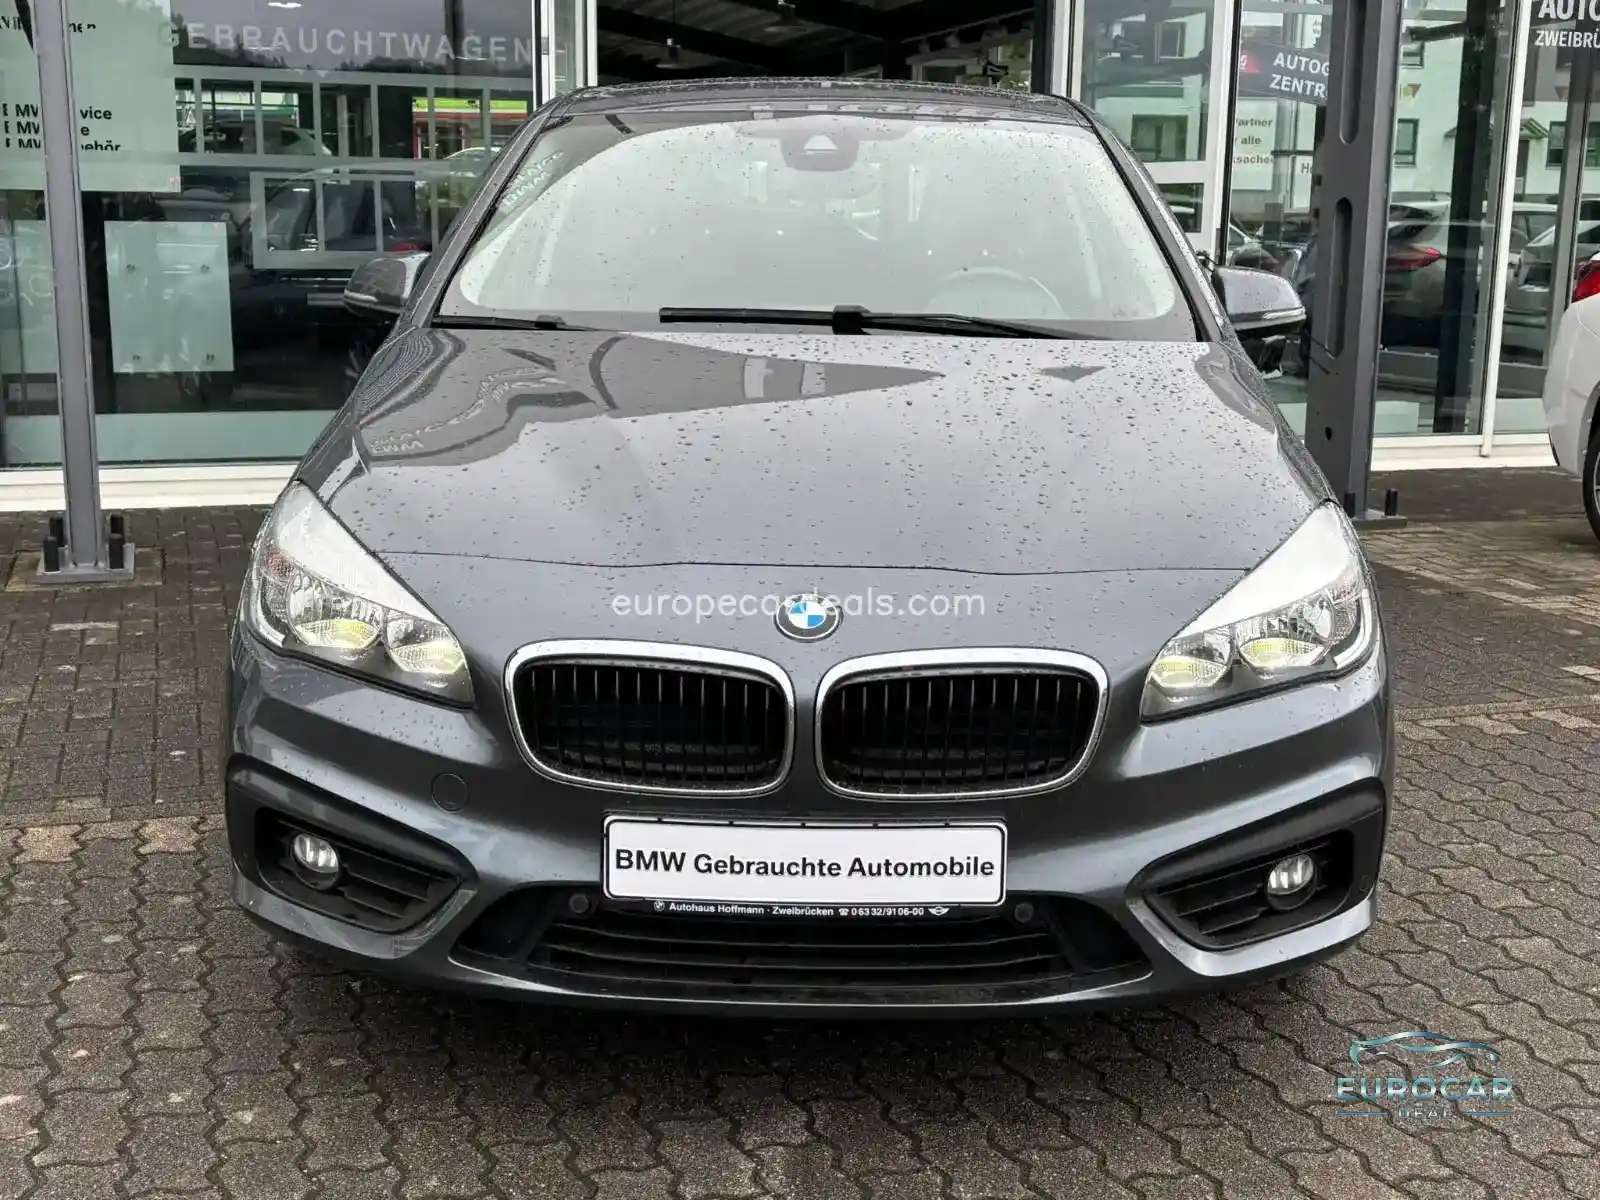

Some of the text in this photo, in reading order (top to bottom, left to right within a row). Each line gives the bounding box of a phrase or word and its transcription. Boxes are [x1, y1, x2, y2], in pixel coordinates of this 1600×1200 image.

[158, 22, 532, 63] GEBRAUCHTWAGEN
[1269, 73, 1328, 98] ZENTR
[615, 848, 995, 877] BMW Gebrauchte Automobile
[669, 902, 716, 912] Autohaus
[717, 904, 765, 915] Hoffmann
[772, 906, 834, 916] Zweibrücken
